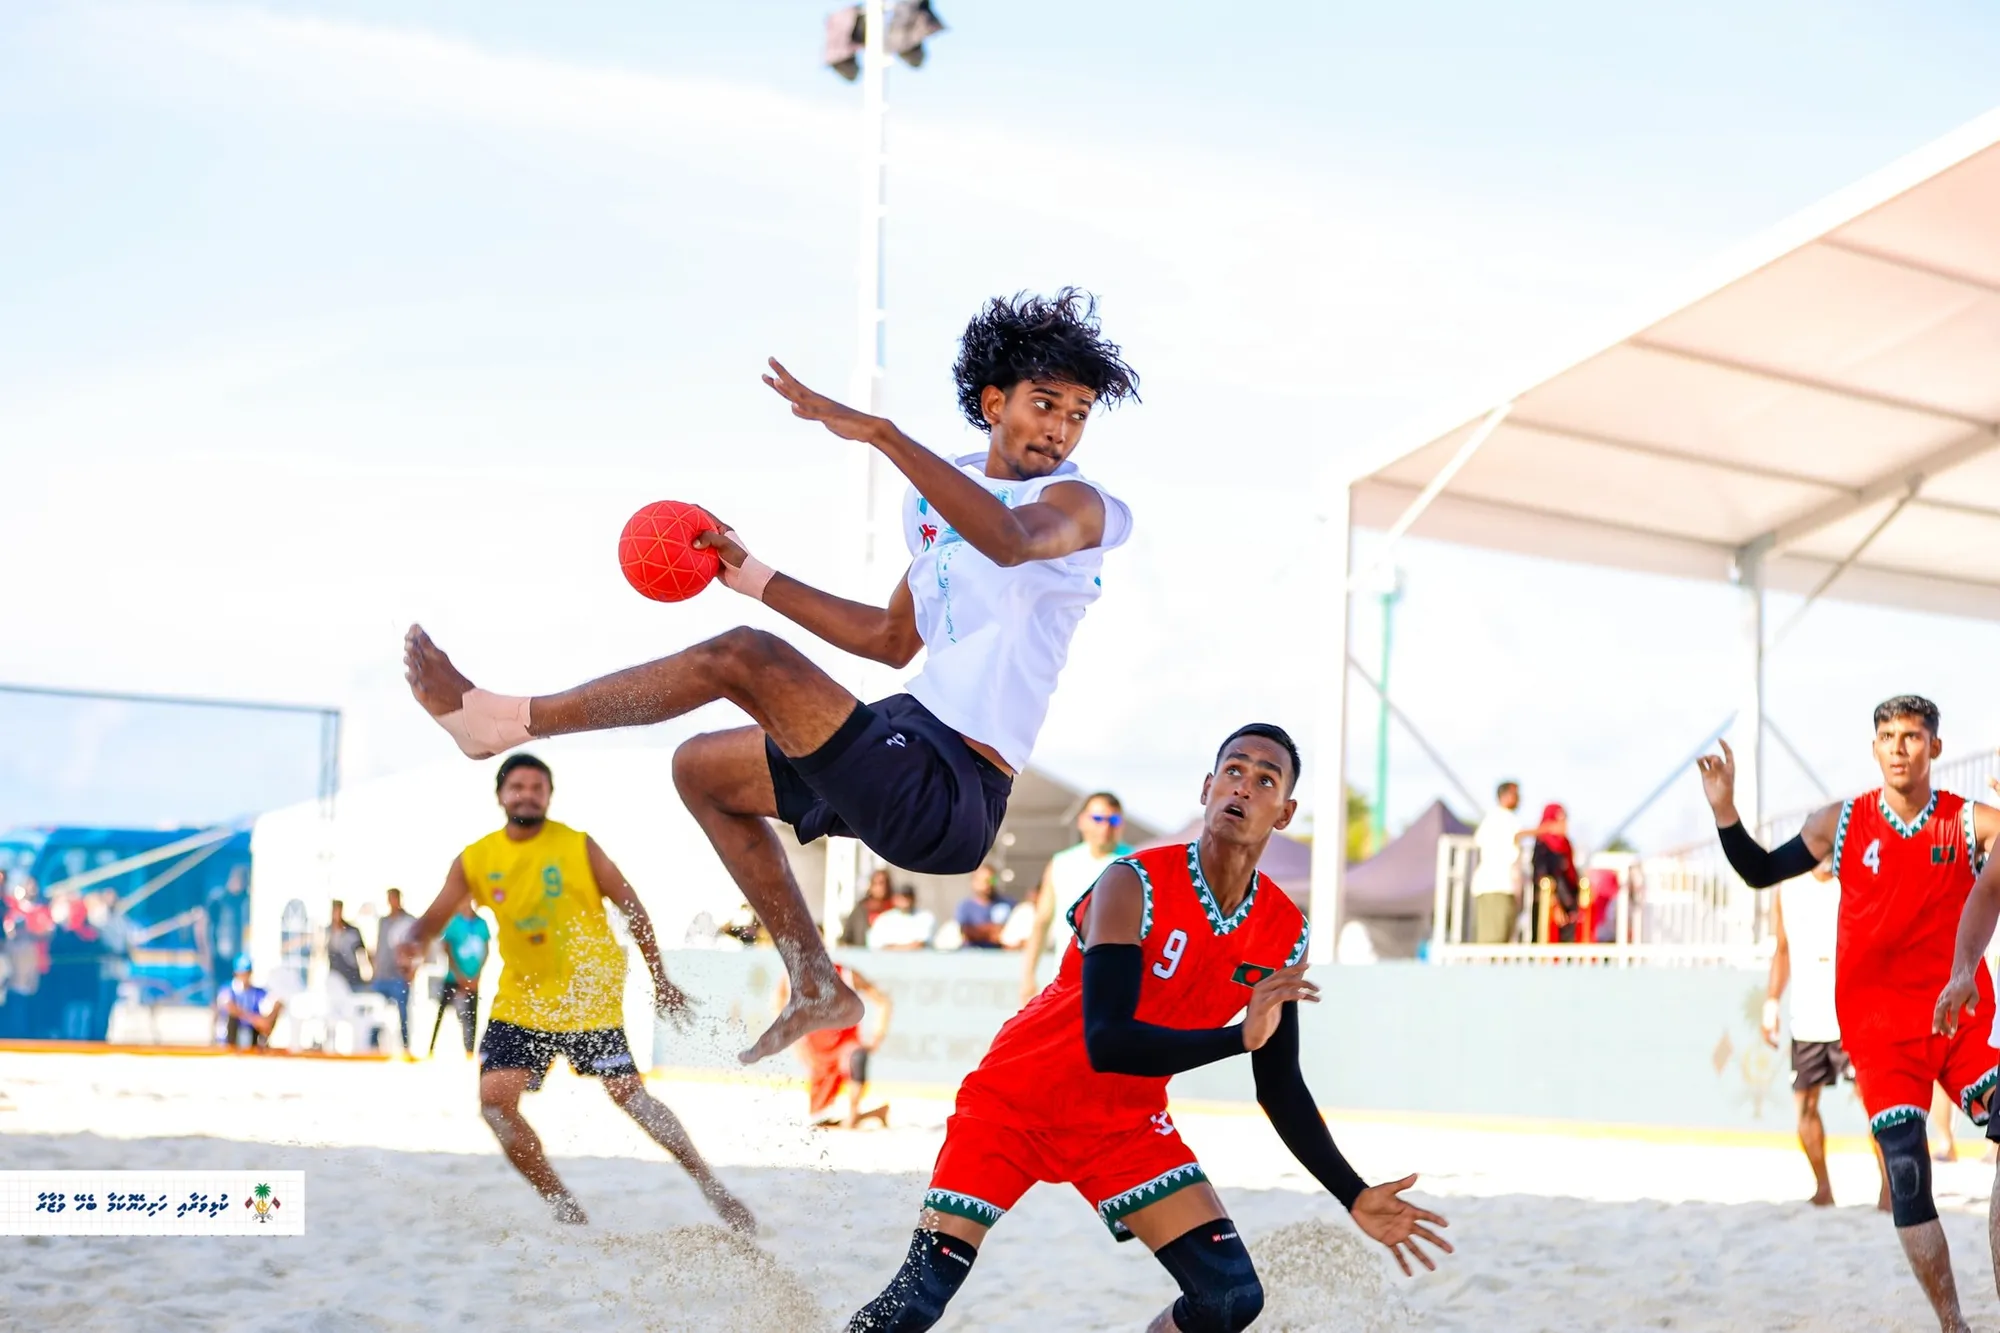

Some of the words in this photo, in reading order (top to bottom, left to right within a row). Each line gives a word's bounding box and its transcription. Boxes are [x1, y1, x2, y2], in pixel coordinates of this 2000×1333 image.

[1862, 837, 1881, 876] 4
[541, 865, 563, 898] 9
[1152, 928, 1188, 980] 9
